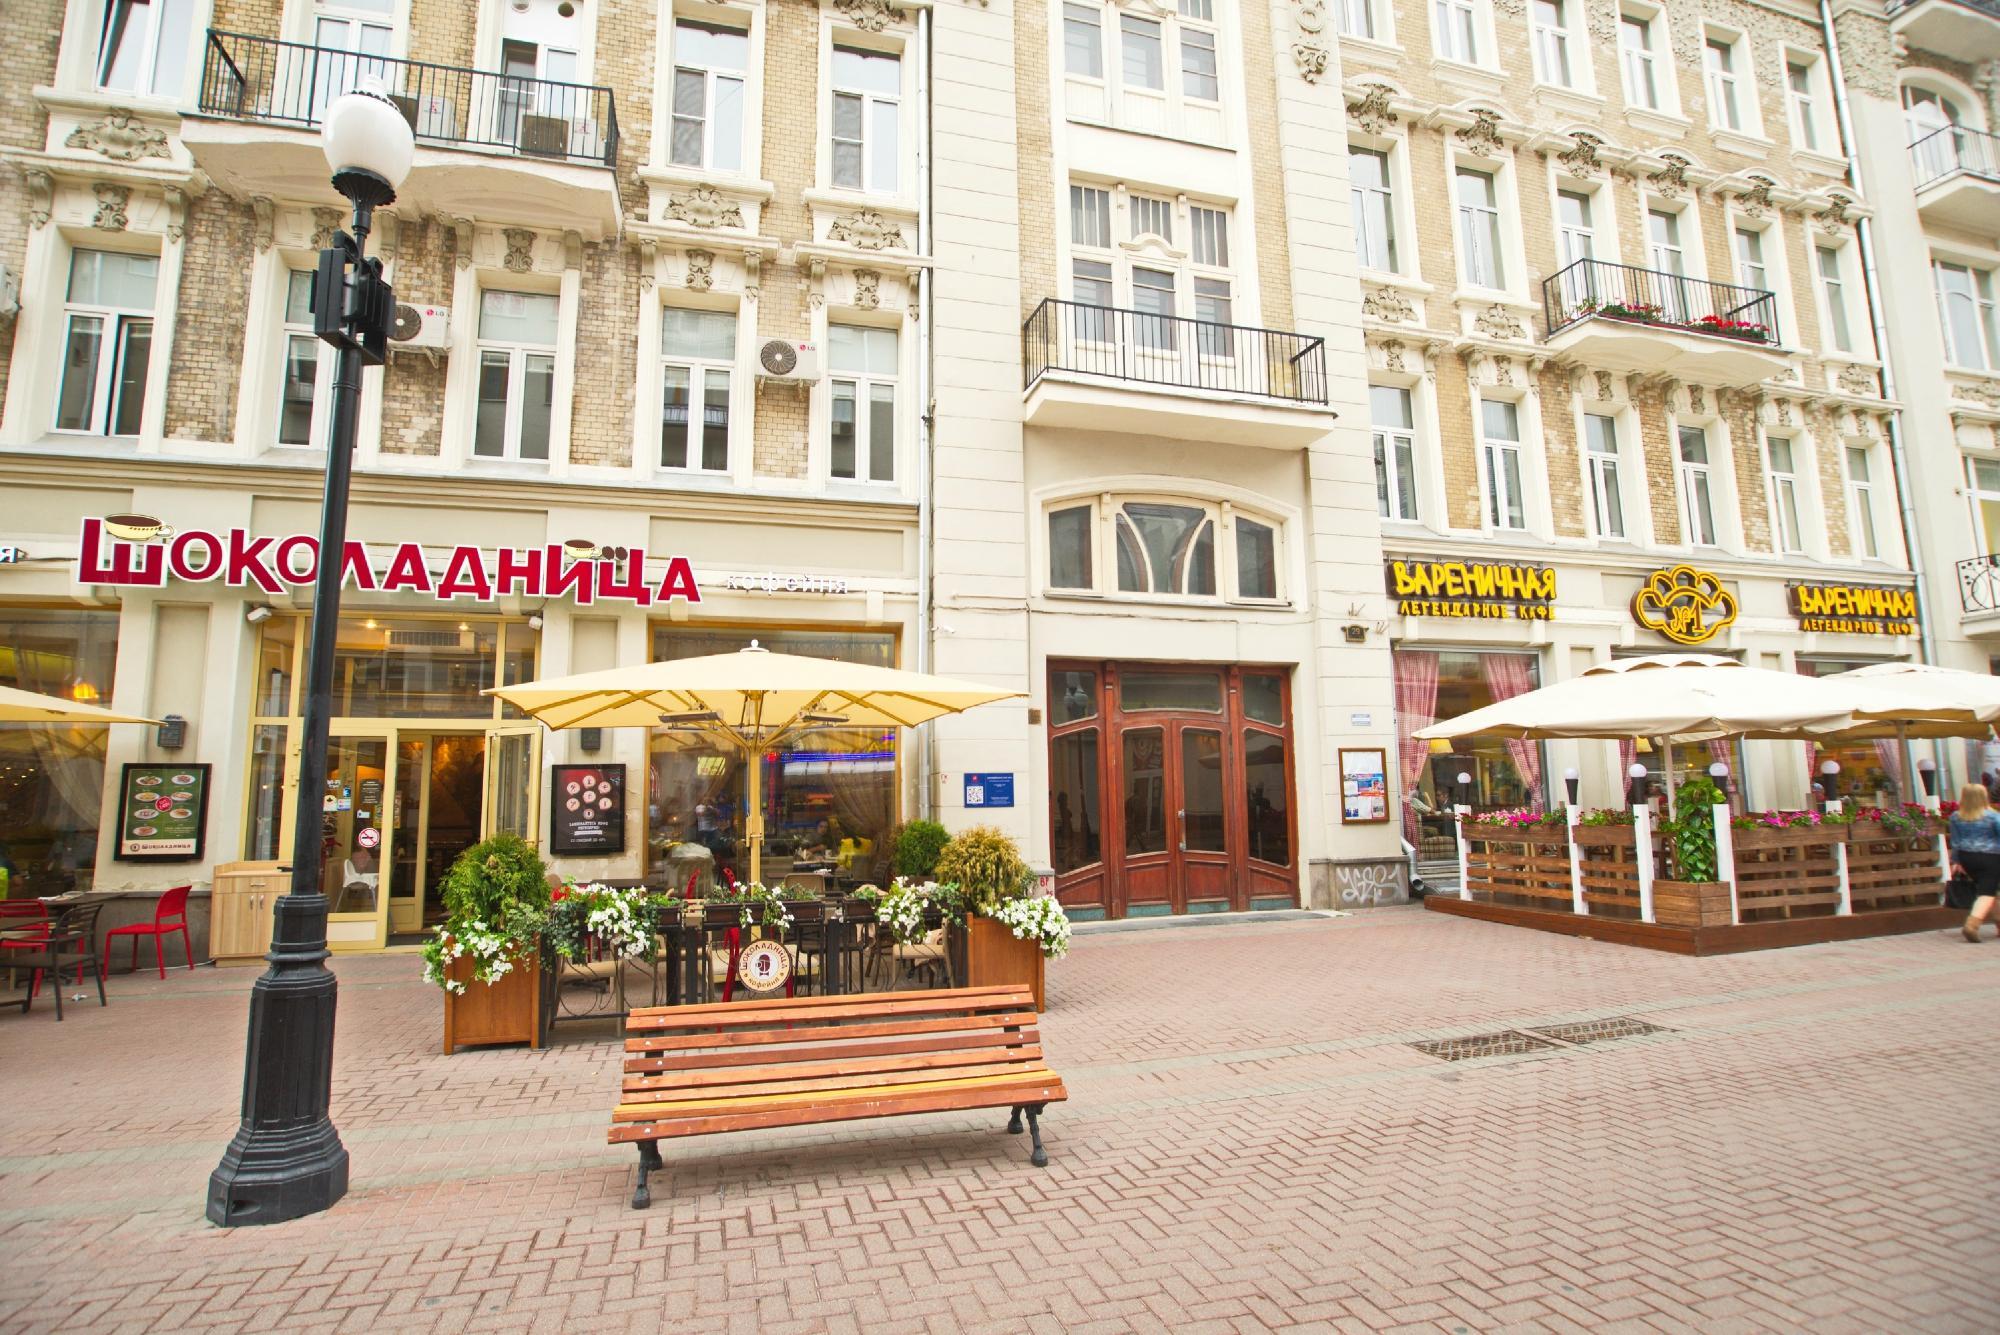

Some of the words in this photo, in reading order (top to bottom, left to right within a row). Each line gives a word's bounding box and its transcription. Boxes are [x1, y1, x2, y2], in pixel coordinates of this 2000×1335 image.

[77, 515, 703, 605] ШОКОЛАДНИЦА
[727, 572, 848, 594] кофейня
[1392, 561, 1556, 600] ВАРЕНИЧНАЯ
[1400, 600, 1509, 619] ЛЕГЕНДАРНОЕ
[1518, 604, 1556, 620] КАФЕ
[1798, 585, 1917, 618] ВАРЕНИЧНАЯ
[1803, 618, 1884, 634] ЛЕГЕНДАРНОЕ
[1887, 621, 1915, 635] КАФЕ
[742, 943, 787, 970] ШОКОЛАДНИЦА
